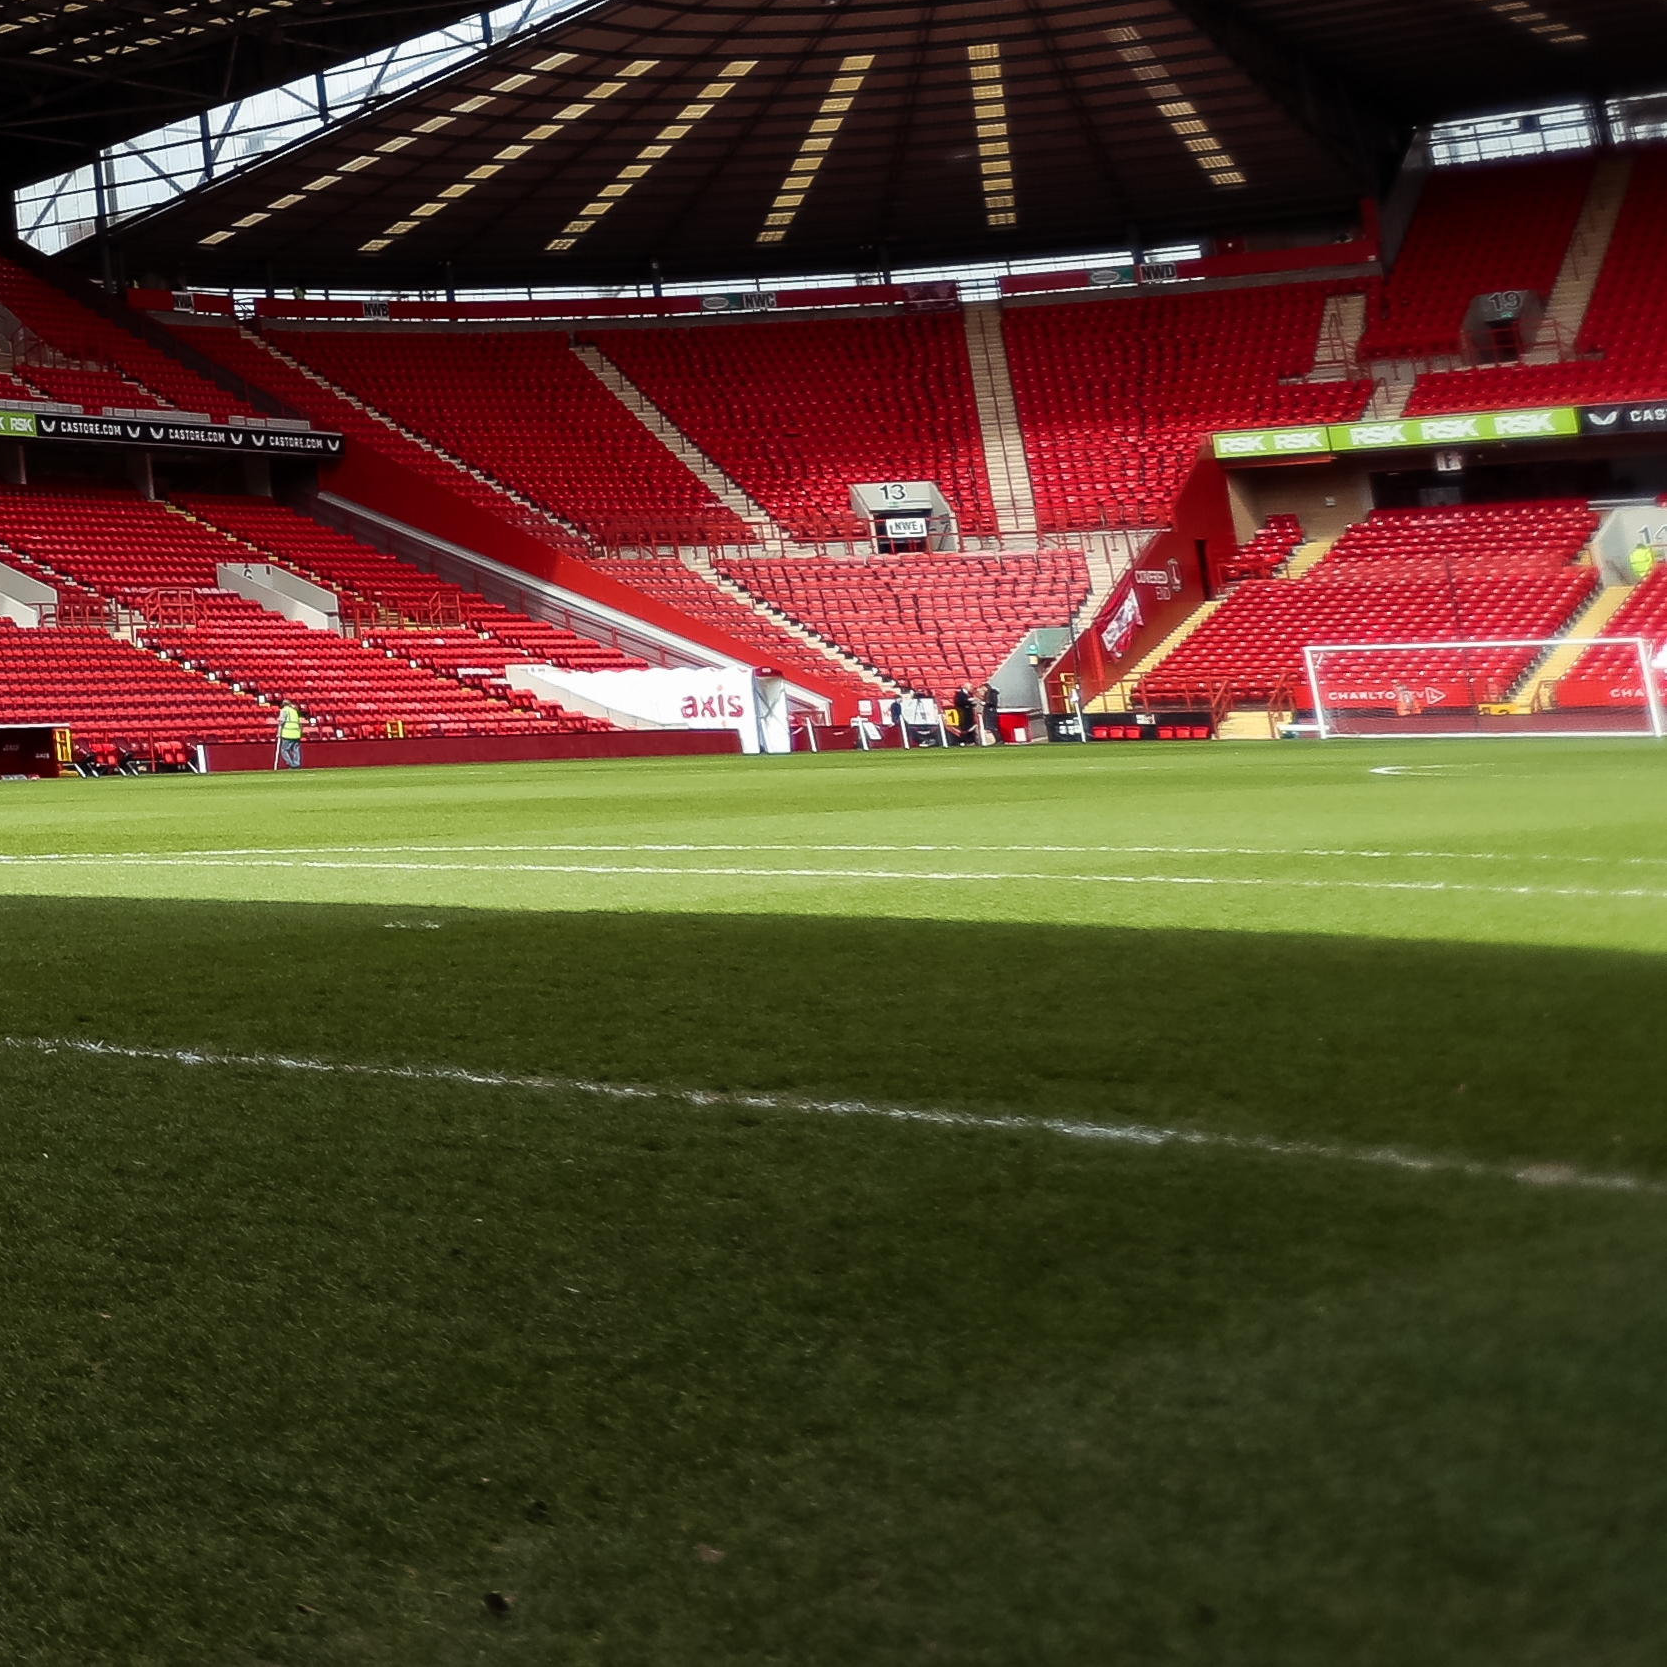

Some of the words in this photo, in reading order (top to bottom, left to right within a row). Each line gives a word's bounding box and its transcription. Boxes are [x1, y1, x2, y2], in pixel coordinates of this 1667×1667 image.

[1141, 264, 1175, 281] NWD
[743, 293, 776, 309] NWC
[1488, 290, 1522, 312] 19
[365, 303, 388, 318] NWB
[10, 418, 33, 432] RSK
[60, 420, 121, 436] CASTORE.COM
[1219, 436, 1266, 453] RSK
[1274, 432, 1323, 450] RSK
[1350, 424, 1406, 445] RSK
[1420, 418, 1479, 440] RSK
[1494, 412, 1556, 435] RSK
[168, 428, 225, 443] CASTORE.COM
[269, 435, 323, 450] CASTORE.COM
[879, 484, 905, 500] 13
[894, 520, 918, 531] NWE
[681, 684, 744, 719] axis
